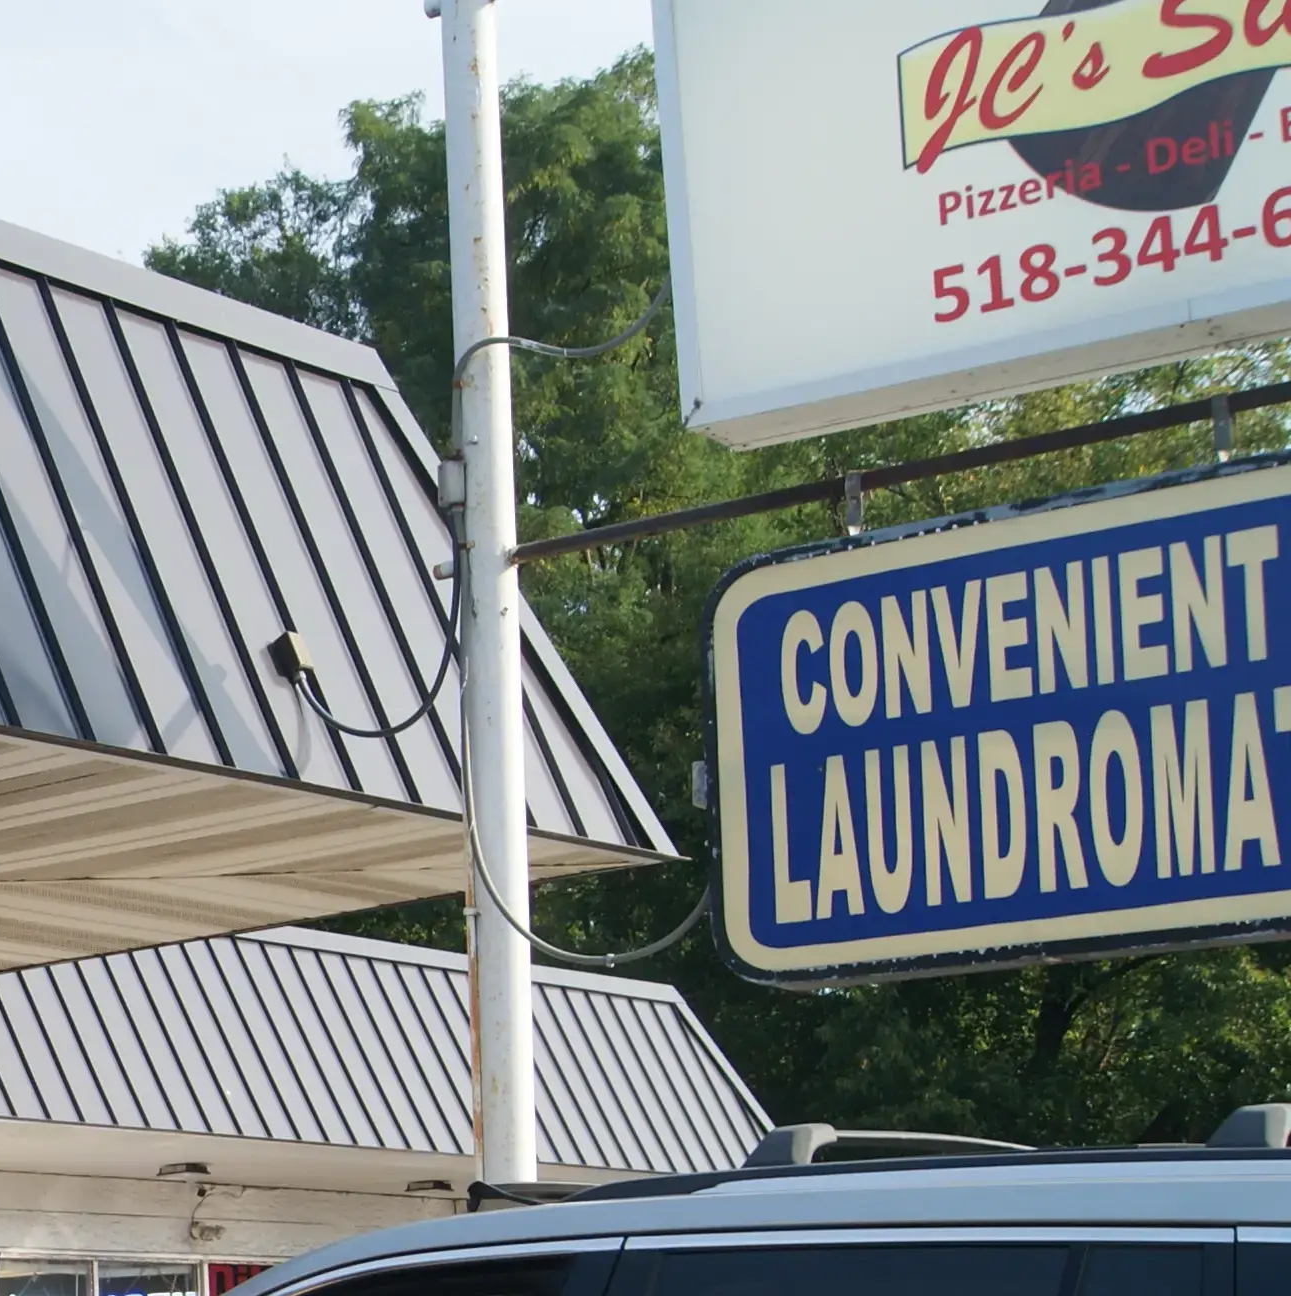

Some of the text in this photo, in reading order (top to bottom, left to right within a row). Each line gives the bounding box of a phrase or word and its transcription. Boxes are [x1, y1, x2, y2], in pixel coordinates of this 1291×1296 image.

[916, 25, 1111, 175] JC's
[938, 159, 1103, 226] Pizzeria
[1145, 121, 1234, 176] Deli
[932, 185, 1291, 324] 518-344-6
[780, 524, 1279, 735] CONVENIENT
